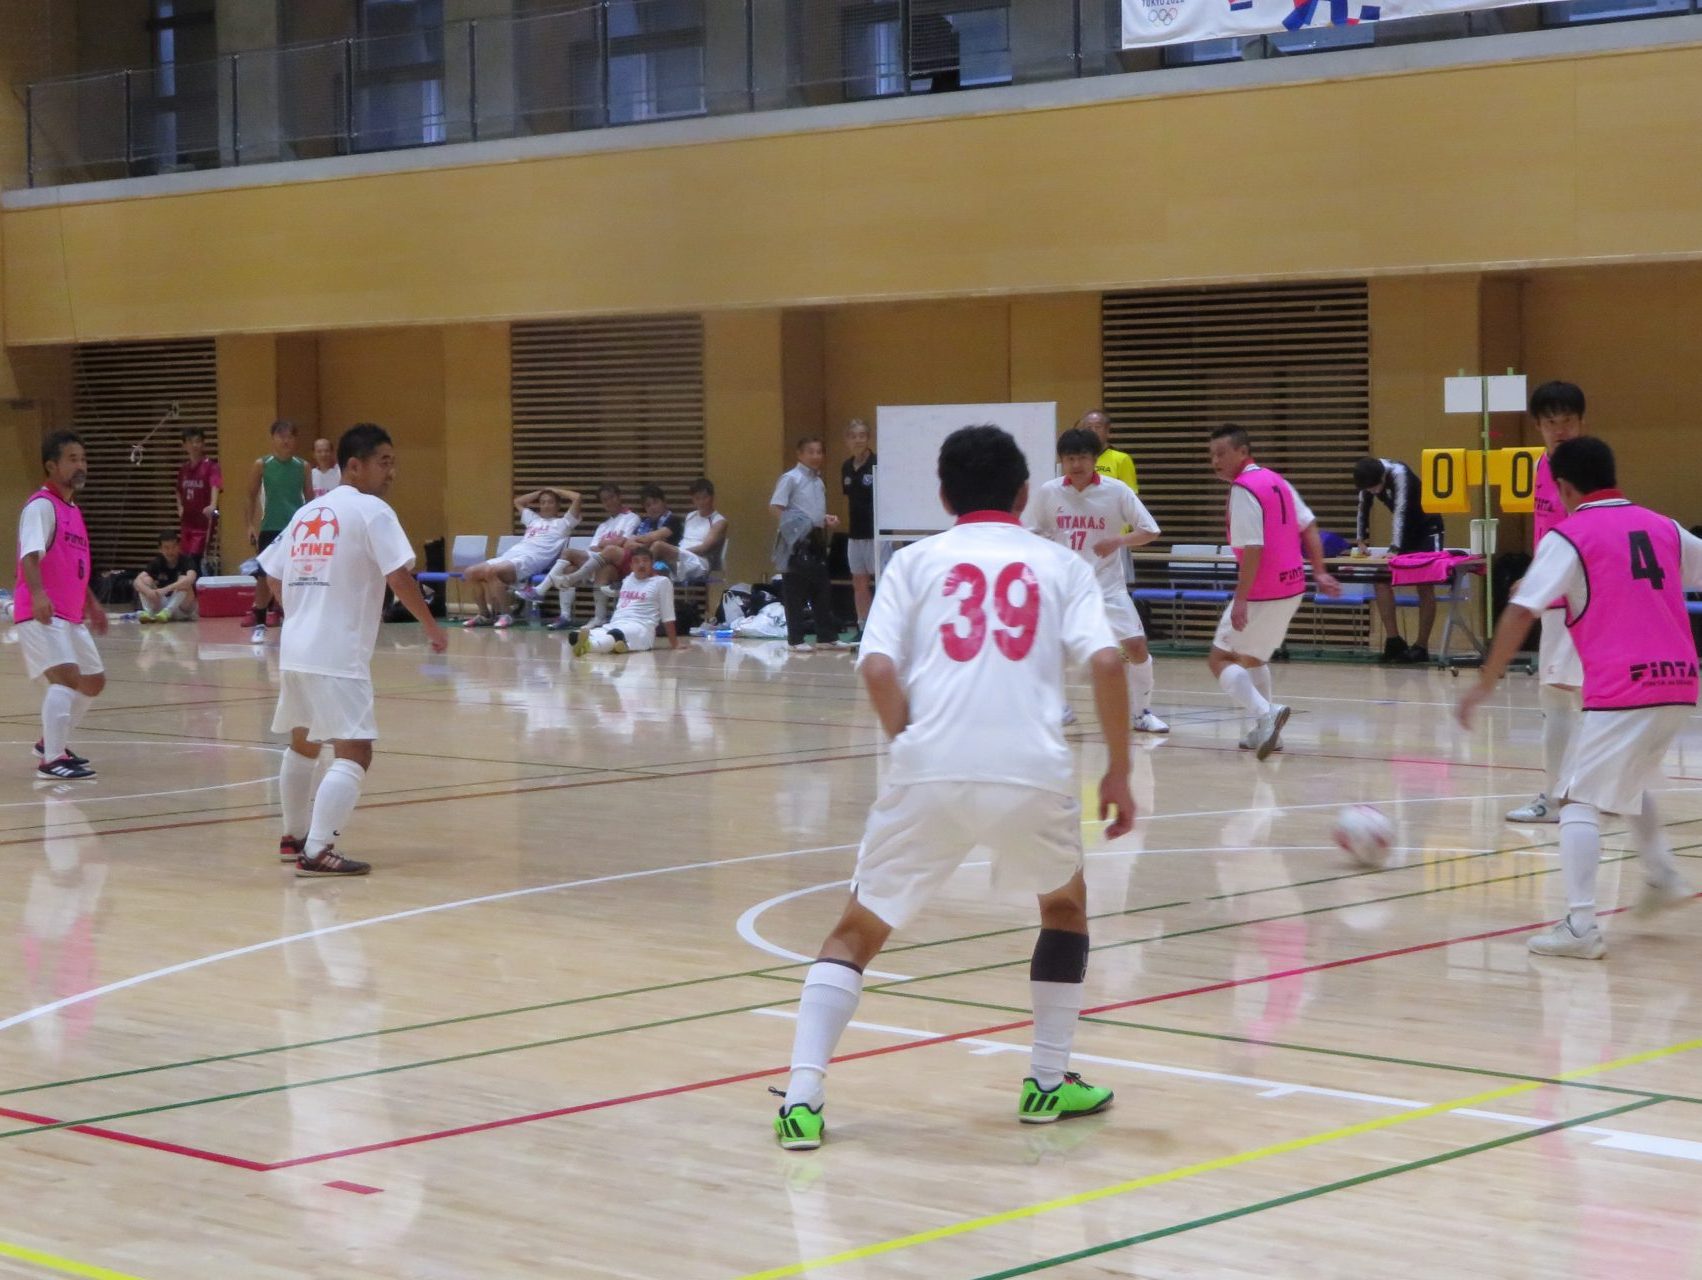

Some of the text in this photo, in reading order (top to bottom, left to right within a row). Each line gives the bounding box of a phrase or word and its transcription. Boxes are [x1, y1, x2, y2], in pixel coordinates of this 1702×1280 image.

[1433, 451, 1533, 498] 0 0
[1070, 531, 1087, 550] 17
[1628, 530, 1665, 590] 4
[939, 562, 1040, 662] 39
